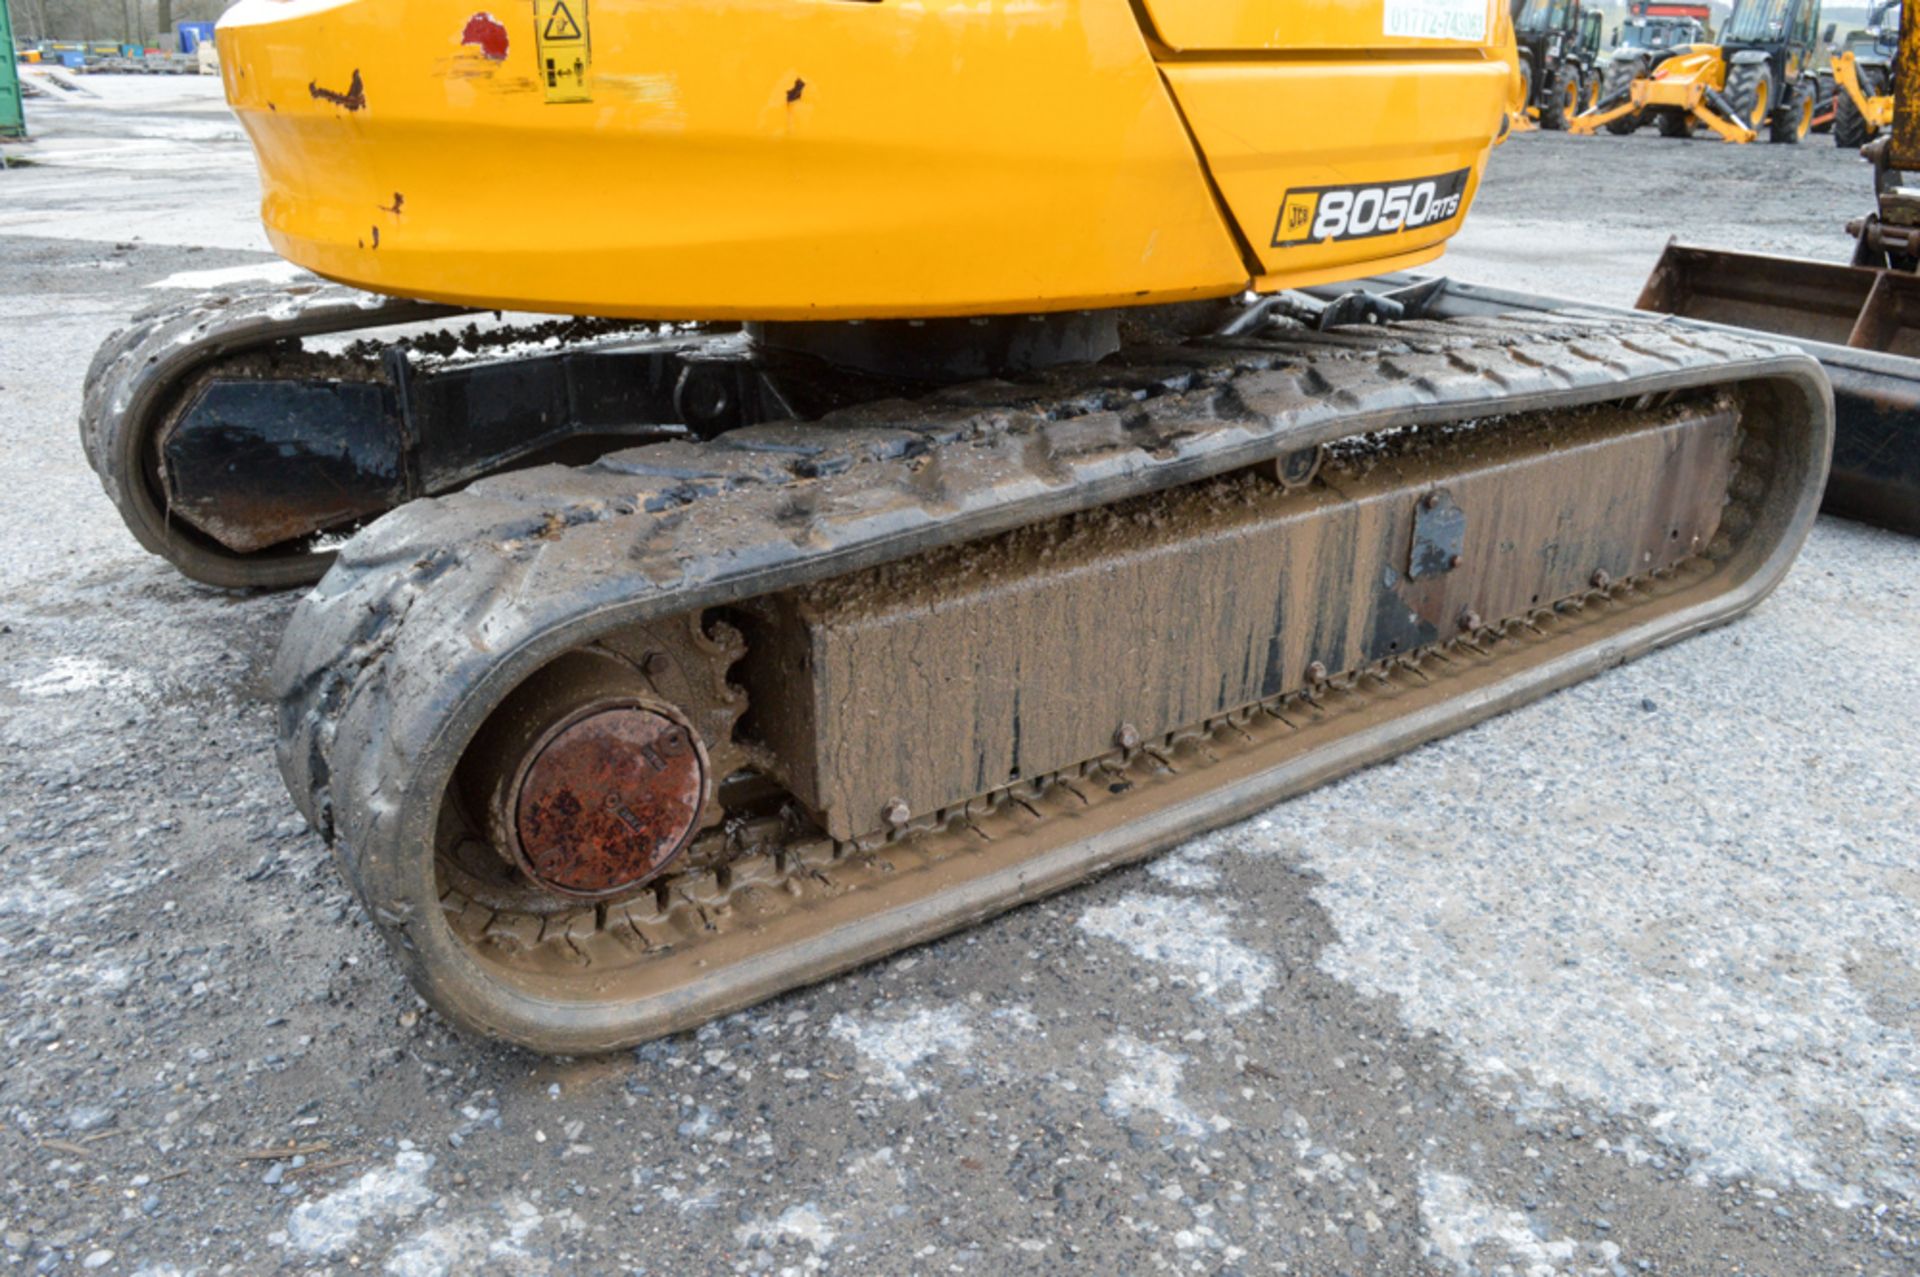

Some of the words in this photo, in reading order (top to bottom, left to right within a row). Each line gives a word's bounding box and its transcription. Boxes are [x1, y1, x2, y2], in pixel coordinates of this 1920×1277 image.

[1289, 205, 1308, 228] JCB
[1313, 182, 1436, 239] 8050
[1427, 194, 1460, 222] RTS
